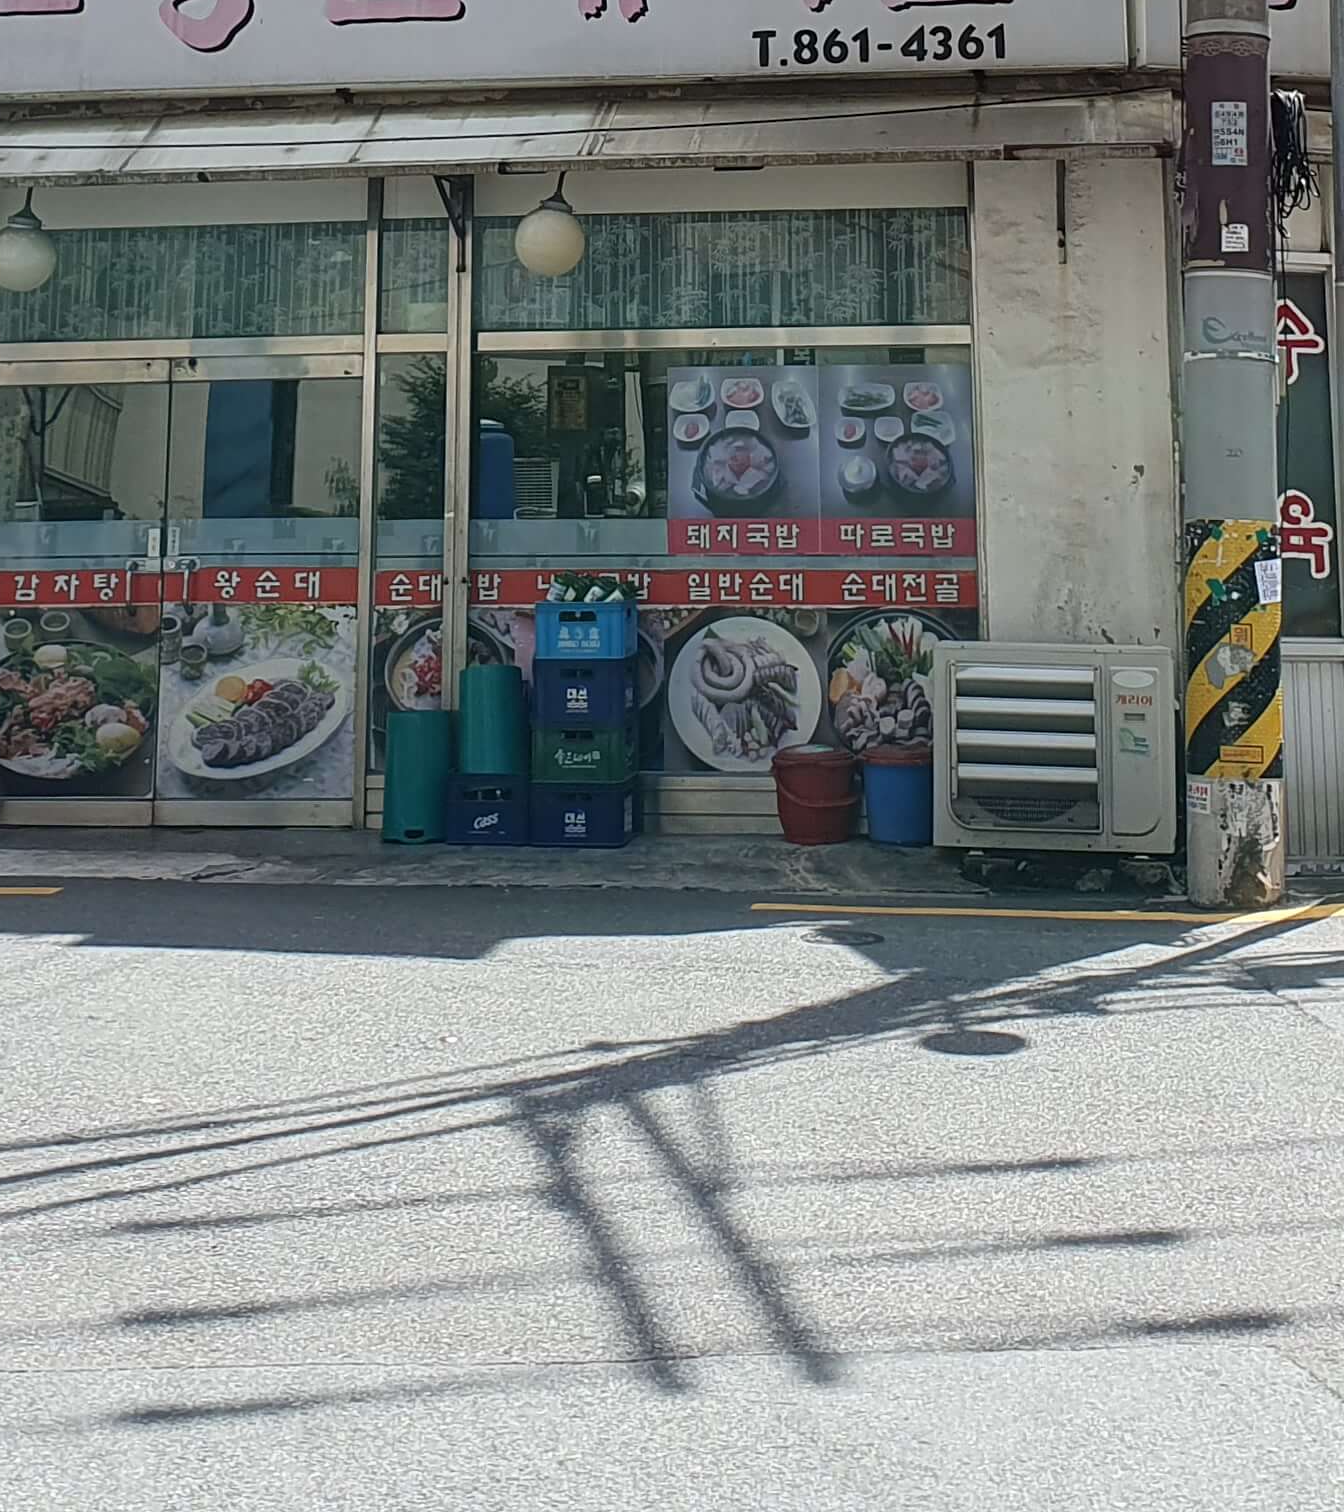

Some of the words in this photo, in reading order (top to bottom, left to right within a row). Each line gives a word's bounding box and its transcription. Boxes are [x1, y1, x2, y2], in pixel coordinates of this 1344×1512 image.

[752, 23, 1009, 70] T.861-4361
[687, 523, 800, 550] 돼지국밥
[839, 523, 956, 550] 따로국밥
[14, 572, 119, 602] 감자탕
[213, 569, 321, 601] 왕순대
[687, 572, 805, 602] 일반순대
[841, 572, 960, 603] 순대전골
